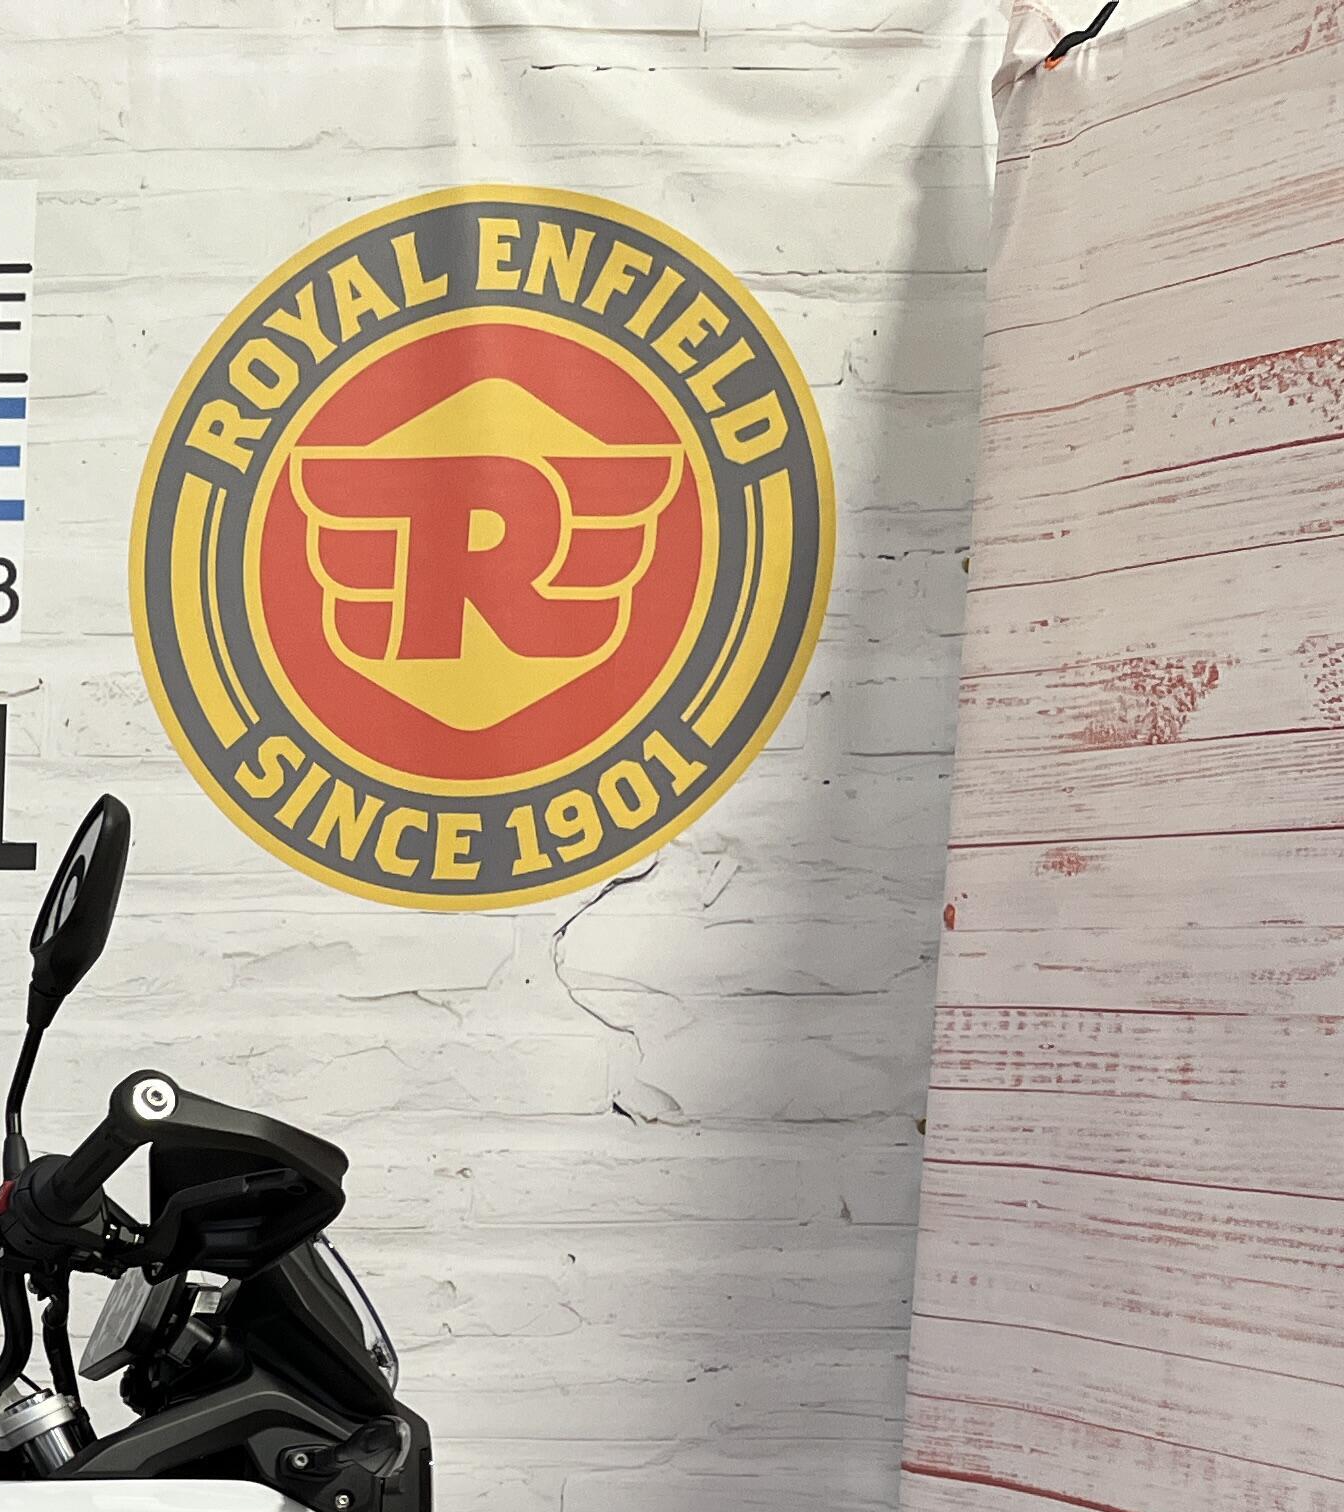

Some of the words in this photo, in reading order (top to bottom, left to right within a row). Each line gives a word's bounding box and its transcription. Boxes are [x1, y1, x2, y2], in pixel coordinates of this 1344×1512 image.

[185, 231, 448, 474] ROYAL
[476, 217, 789, 465] ENFIELD
[234, 735, 482, 881] SINCE
[506, 728, 708, 876] 1901
